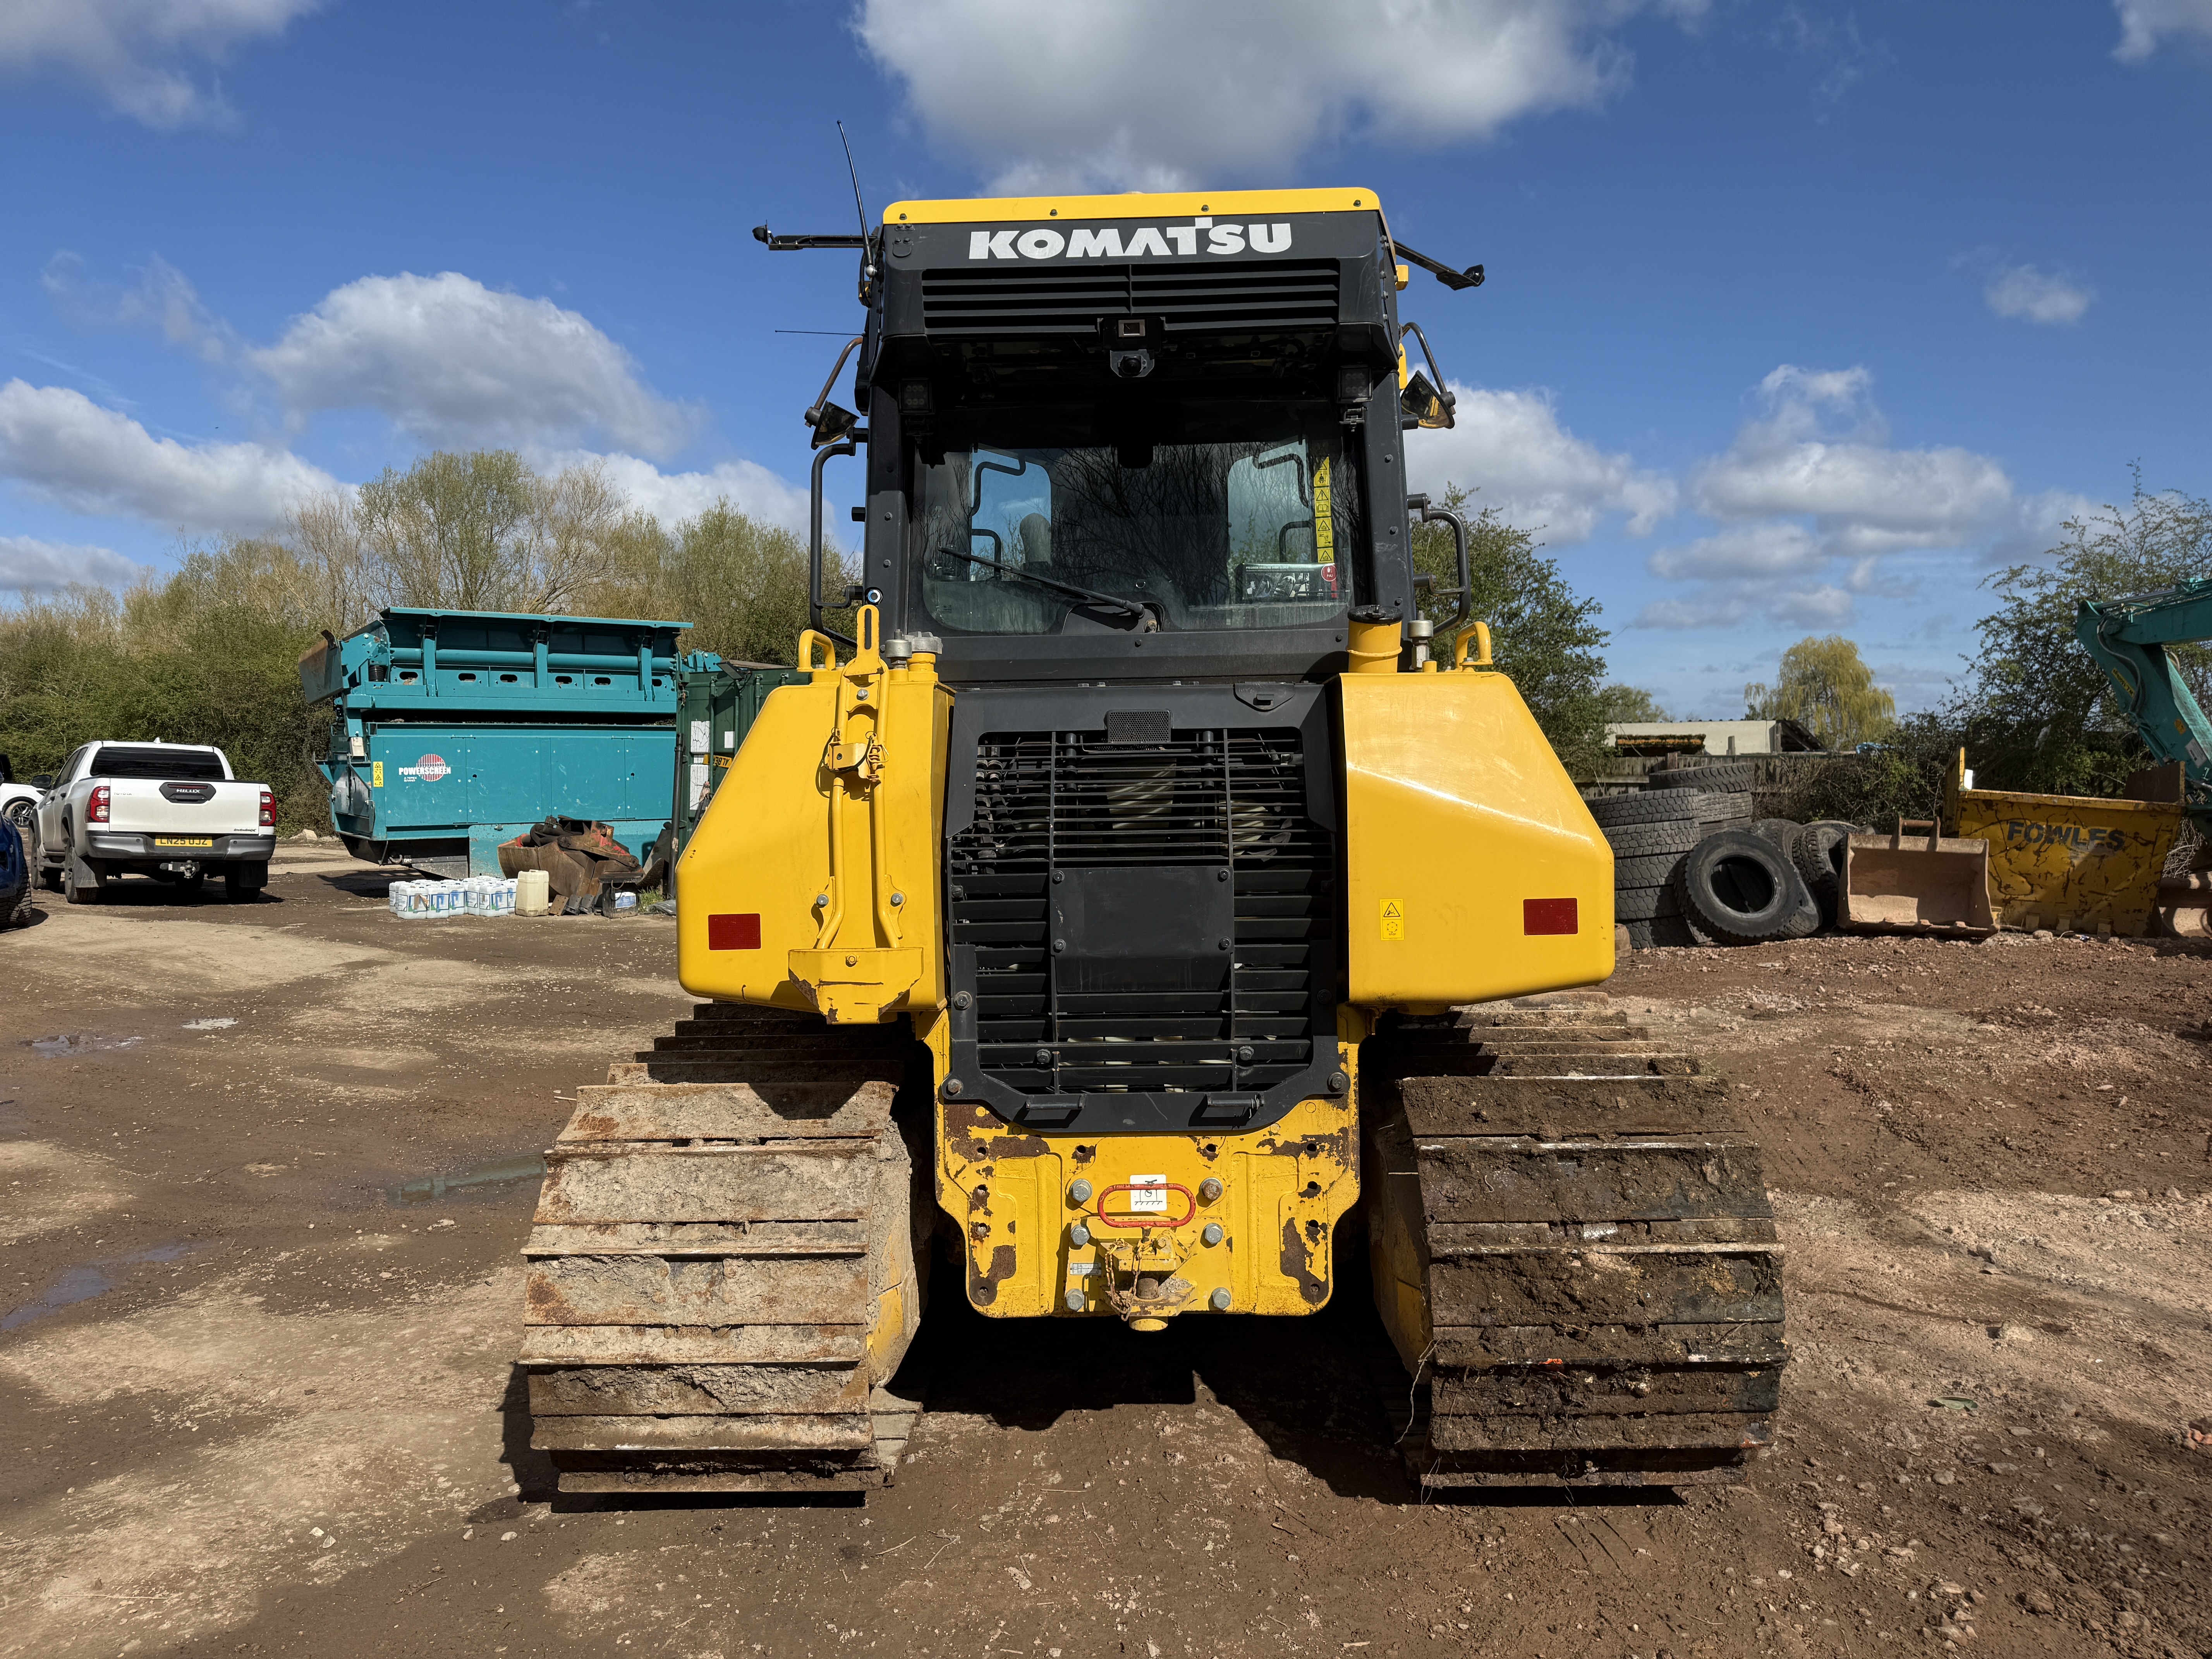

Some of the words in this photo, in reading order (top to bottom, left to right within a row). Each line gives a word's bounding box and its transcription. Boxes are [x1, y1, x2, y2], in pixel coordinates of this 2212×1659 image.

[969, 217, 1292, 259] KOMATSU
[713, 756, 730, 766] ALBE
[398, 766, 452, 775] POWERSCREEN
[189, 837, 208, 845] UJZ
[2007, 821, 2126, 851] FOWLES
